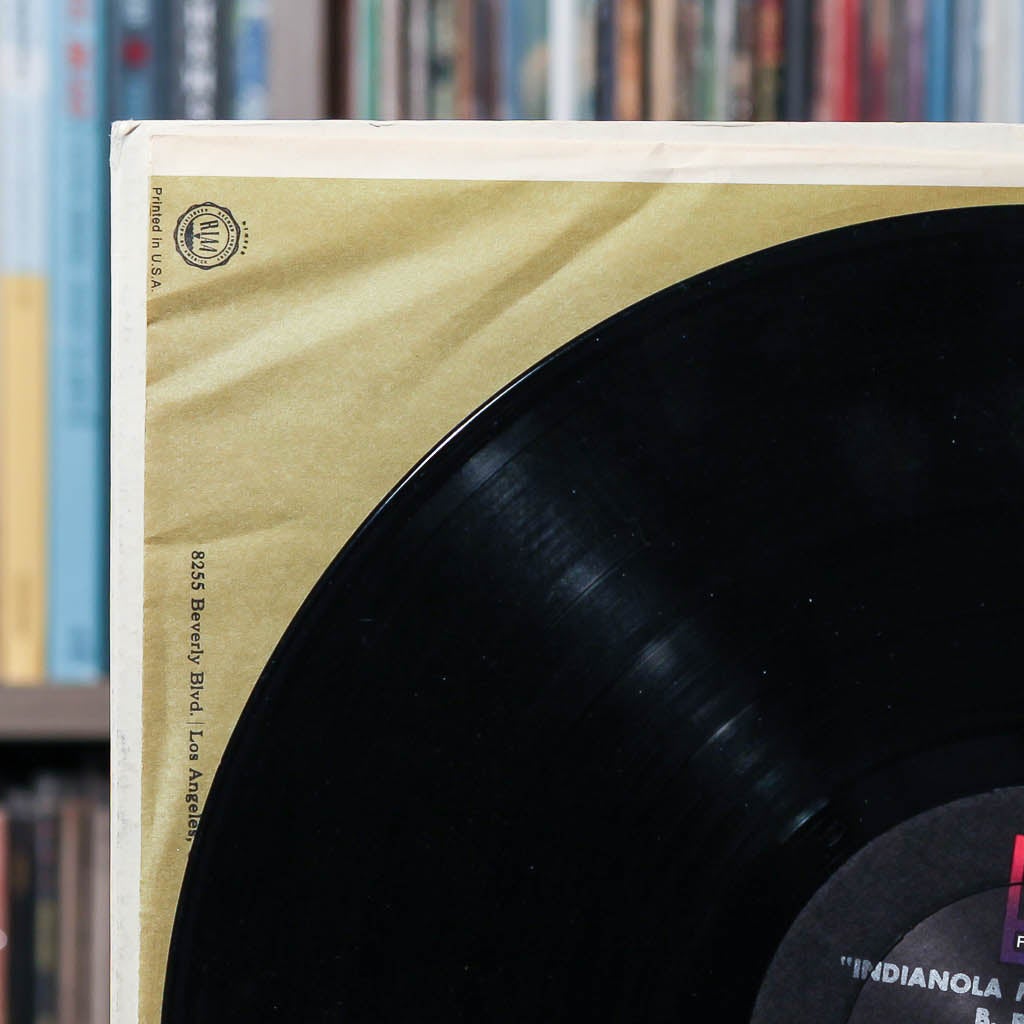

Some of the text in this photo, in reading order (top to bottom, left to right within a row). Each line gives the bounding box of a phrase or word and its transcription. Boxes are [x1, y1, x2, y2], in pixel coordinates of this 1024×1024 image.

[151, 187, 162, 292] Printed in U.S.A.
[185, 550, 205, 842] 8255 Beverly Blvd. Los Angeles,
